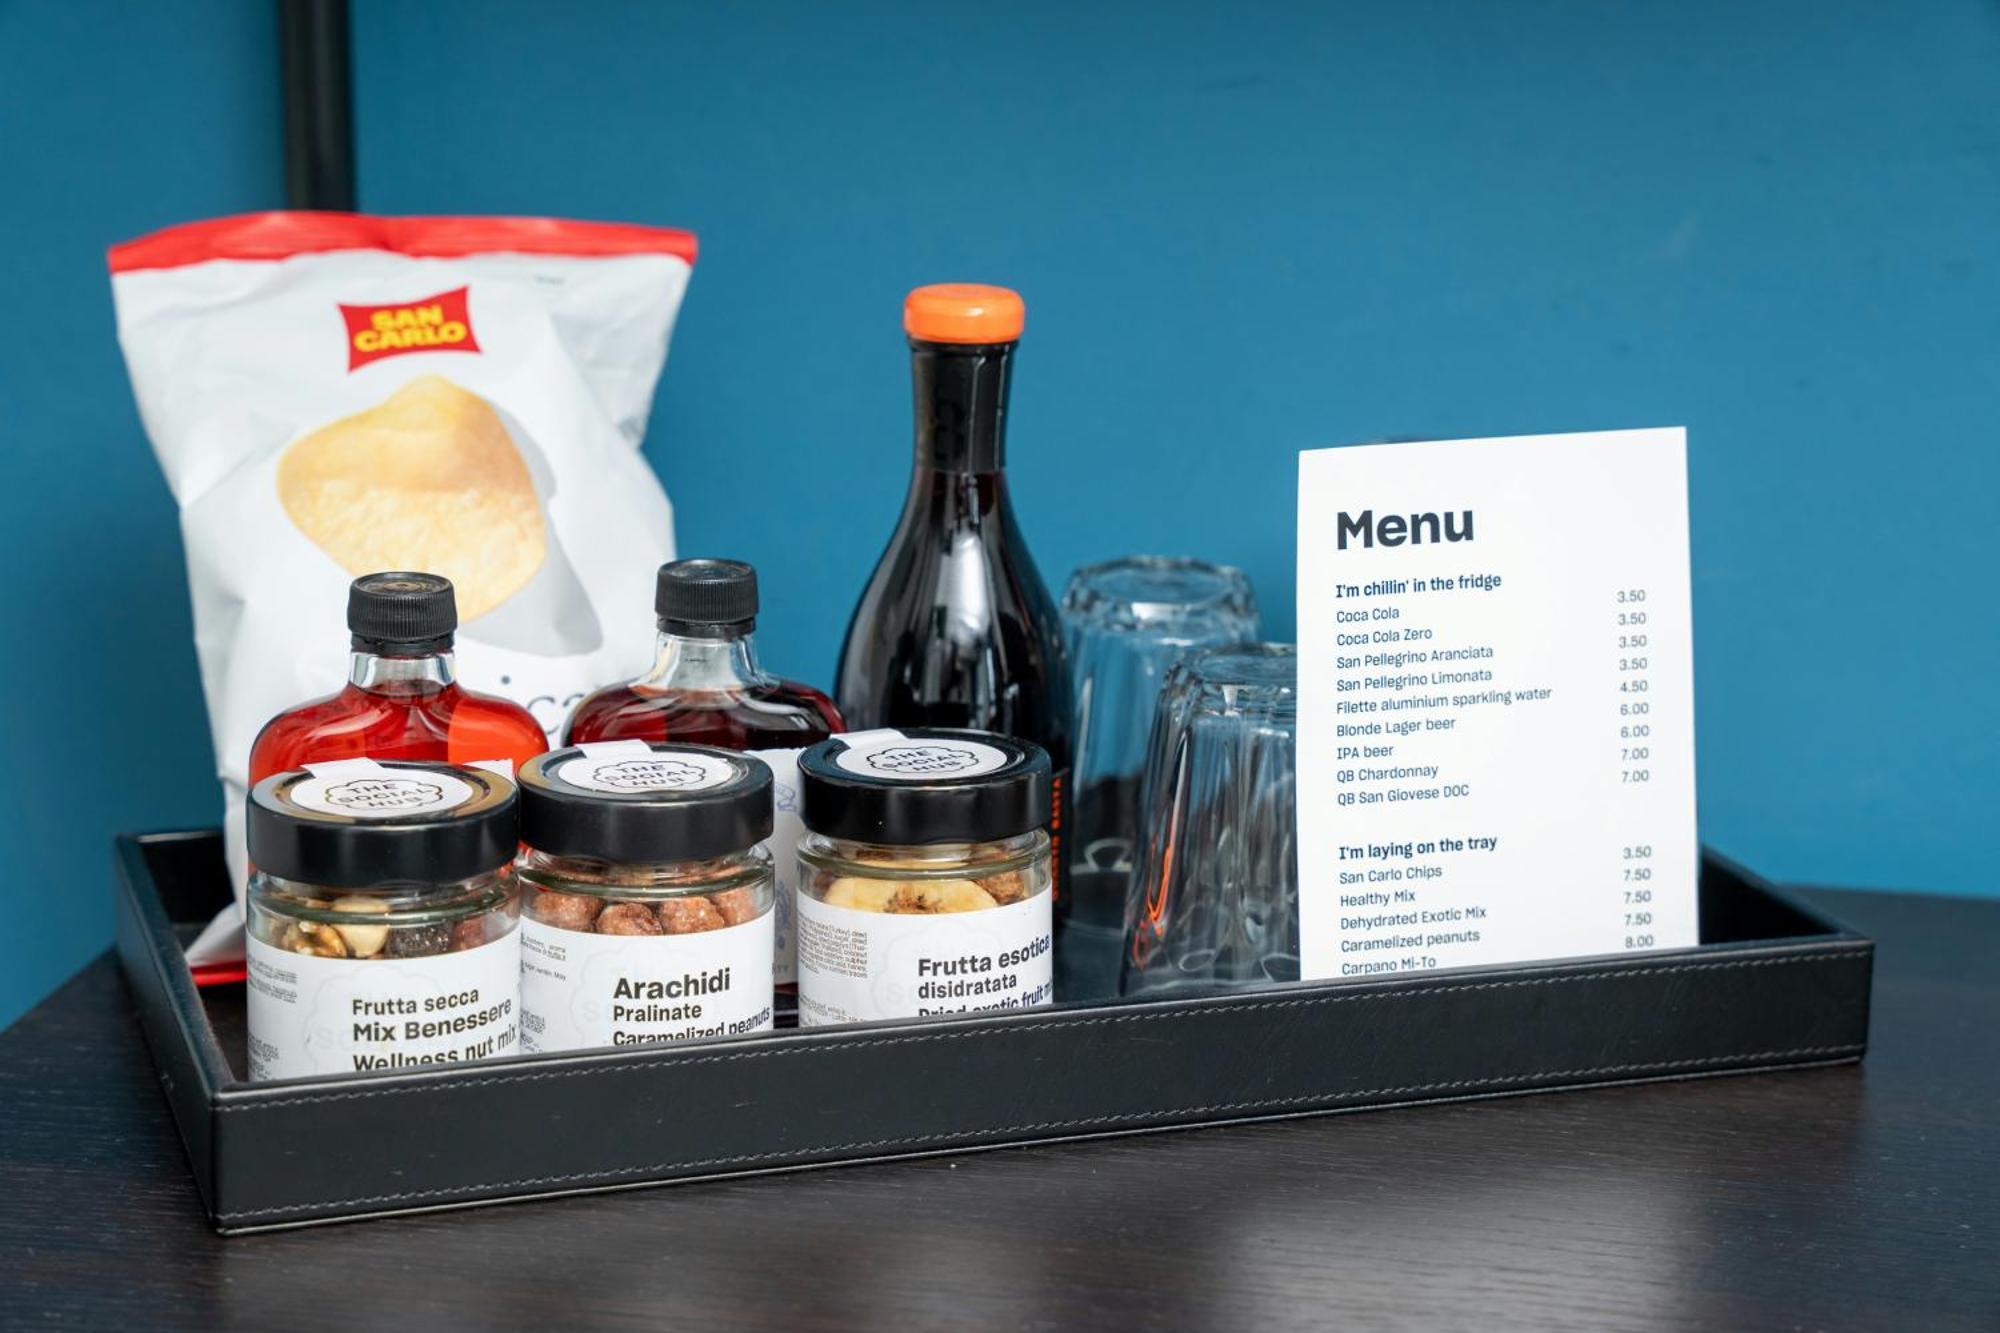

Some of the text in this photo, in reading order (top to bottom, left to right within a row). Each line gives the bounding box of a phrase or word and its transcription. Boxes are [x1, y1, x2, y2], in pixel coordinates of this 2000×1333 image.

[371, 305, 443, 331] SAN
[354, 322, 467, 352] CARLO
[1336, 510, 1474, 550] Menu
[1336, 574, 1502, 598] I'm chillin' in the fridge
[1618, 590, 1645, 603] 3.50
[1336, 606, 1400, 624] Coca Cola
[1618, 612, 1646, 626] 3.50
[1336, 627, 1432, 646] Coca Cola Zero
[1619, 635, 1647, 648] 3.50
[1337, 645, 1493, 669] San Pellegrino Aranciata
[1620, 658, 1647, 671] 3.50
[1337, 669, 1492, 692] San Pellegrino Limonata
[1620, 680, 1648, 692] 4.50
[1336, 687, 1551, 715] Filette aluminium sparkling water
[1620, 702, 1649, 716] 6.00
[1337, 717, 1456, 737] Blonde Lager beer
[1621, 725, 1649, 738] 6.00
[1337, 745, 1393, 760] IPA beer
[1622, 747, 1649, 760] 7.00
[617, 765, 666, 773] THE
[1337, 764, 1438, 783] QB Chardonnay
[1622, 770, 1649, 782] 7.00
[338, 788, 433, 803] SOCIAL
[346, 783, 398, 794] THE
[1337, 785, 1469, 806] QB San Giovese DOC
[1339, 836, 1497, 860] I'm laying on the tray
[1624, 846, 1651, 859] 3.50
[1339, 865, 1443, 884] San Carlo Chips
[1623, 868, 1651, 881] 7.50
[1340, 889, 1416, 908] Healthy Mix
[1624, 890, 1651, 903] 7.50
[1340, 906, 1486, 930] Dehydrated Exotic Mix
[1624, 912, 1652, 926] 7.50
[1341, 929, 1480, 954] Caramelized peanuts
[1625, 935, 1653, 948] 8.00
[918, 934, 1050, 976] Frutta esotica
[1342, 956, 1436, 975] Carpano Mi-To
[613, 967, 730, 999] Arachidi
[918, 974, 1016, 998] disidratata
[353, 989, 479, 1015] Frutta secca
[1022, 986, 1043, 1008] fruit
[353, 1023, 395, 1041] Mix
[405, 999, 511, 1040] Benessere
[614, 1004, 702, 1022] Pralinate
[729, 1007, 770, 1035] peanuts
[353, 1050, 458, 1071] Wellness
[466, 1037, 493, 1061] nut
[498, 1023, 516, 1051] mix
